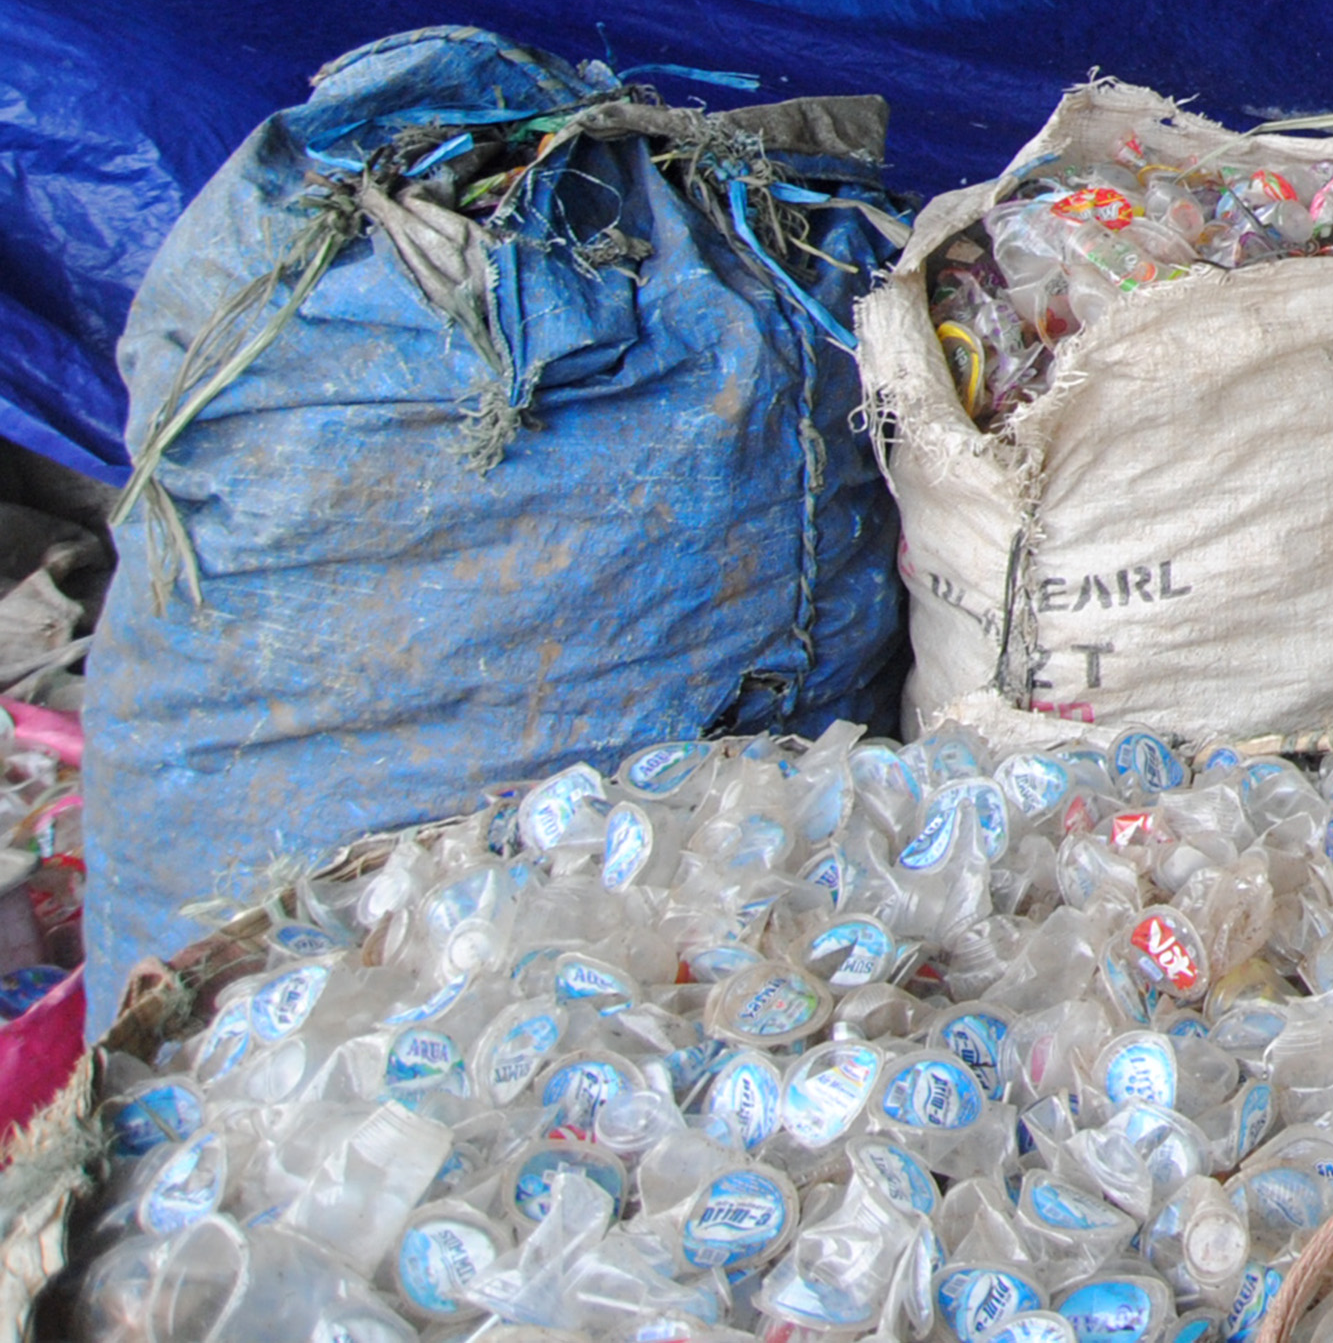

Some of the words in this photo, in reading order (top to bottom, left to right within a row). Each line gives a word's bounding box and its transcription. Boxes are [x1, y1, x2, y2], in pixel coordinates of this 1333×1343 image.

[1147, 918, 1195, 983] Vit
[406, 1038, 451, 1062] AQUA
[930, 1071, 951, 1126] prim-a
[700, 1204, 770, 1228] prim-a
[1227, 1272, 1260, 1331] AQUA
